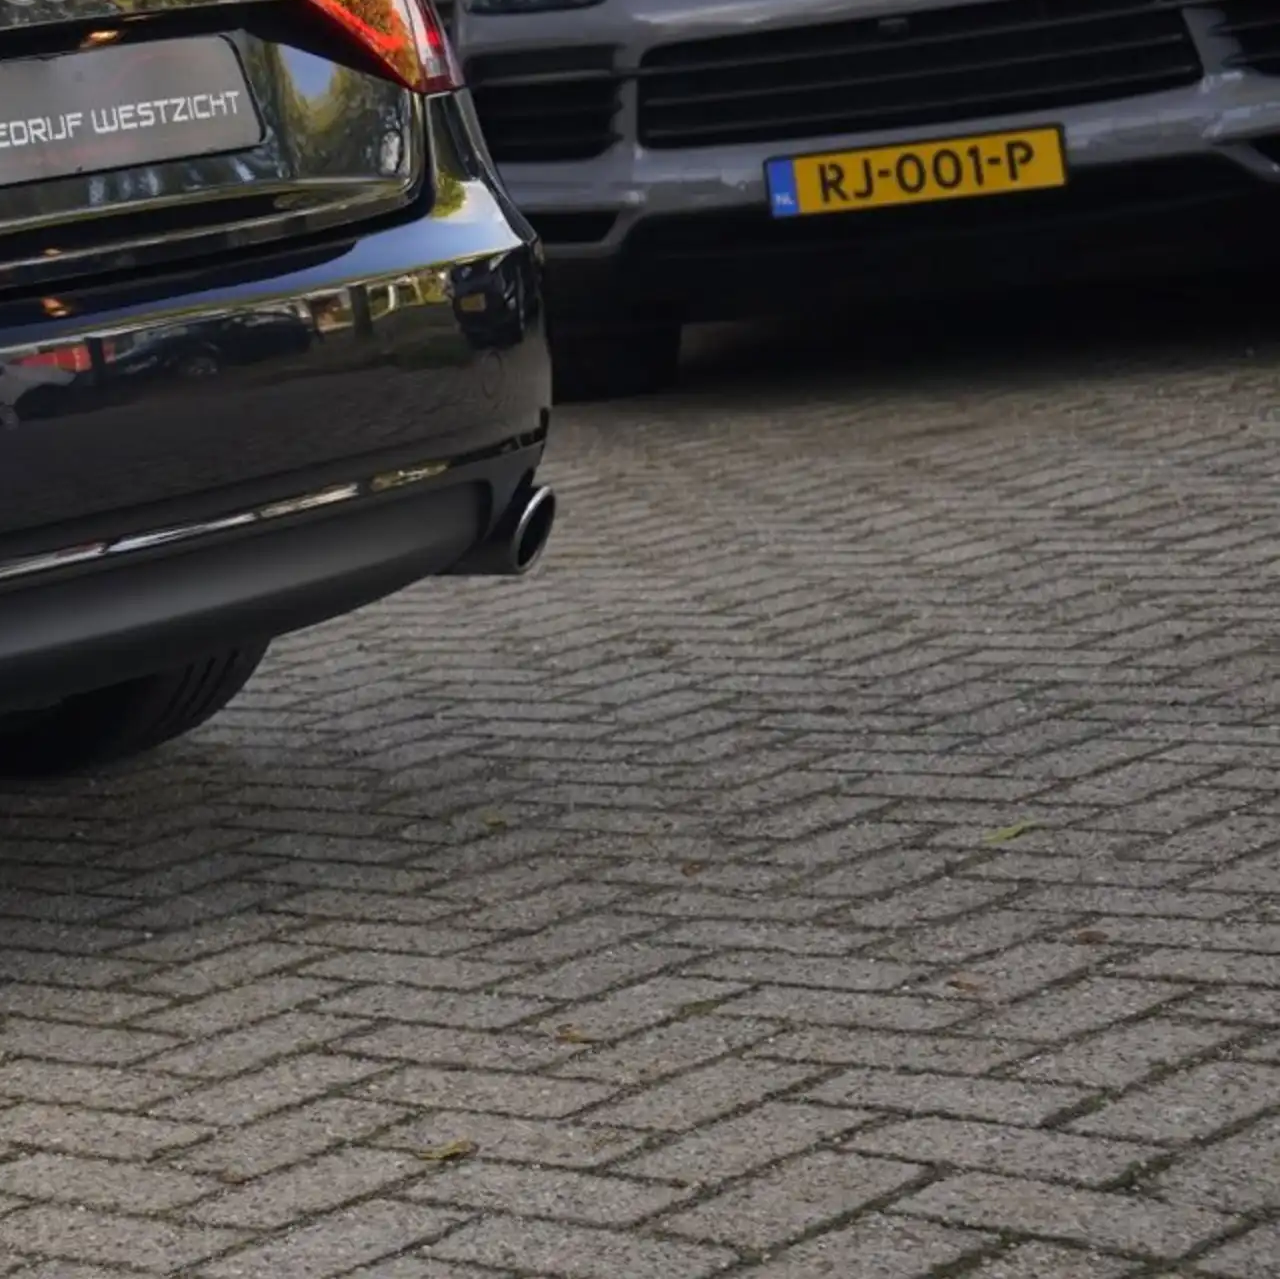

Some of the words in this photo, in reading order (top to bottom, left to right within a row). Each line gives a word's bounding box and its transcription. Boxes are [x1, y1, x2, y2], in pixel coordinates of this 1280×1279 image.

[92, 90, 240, 134] WESTZICHT
[818, 139, 1034, 204] RJ-001-P
[775, 192, 794, 207] NL
